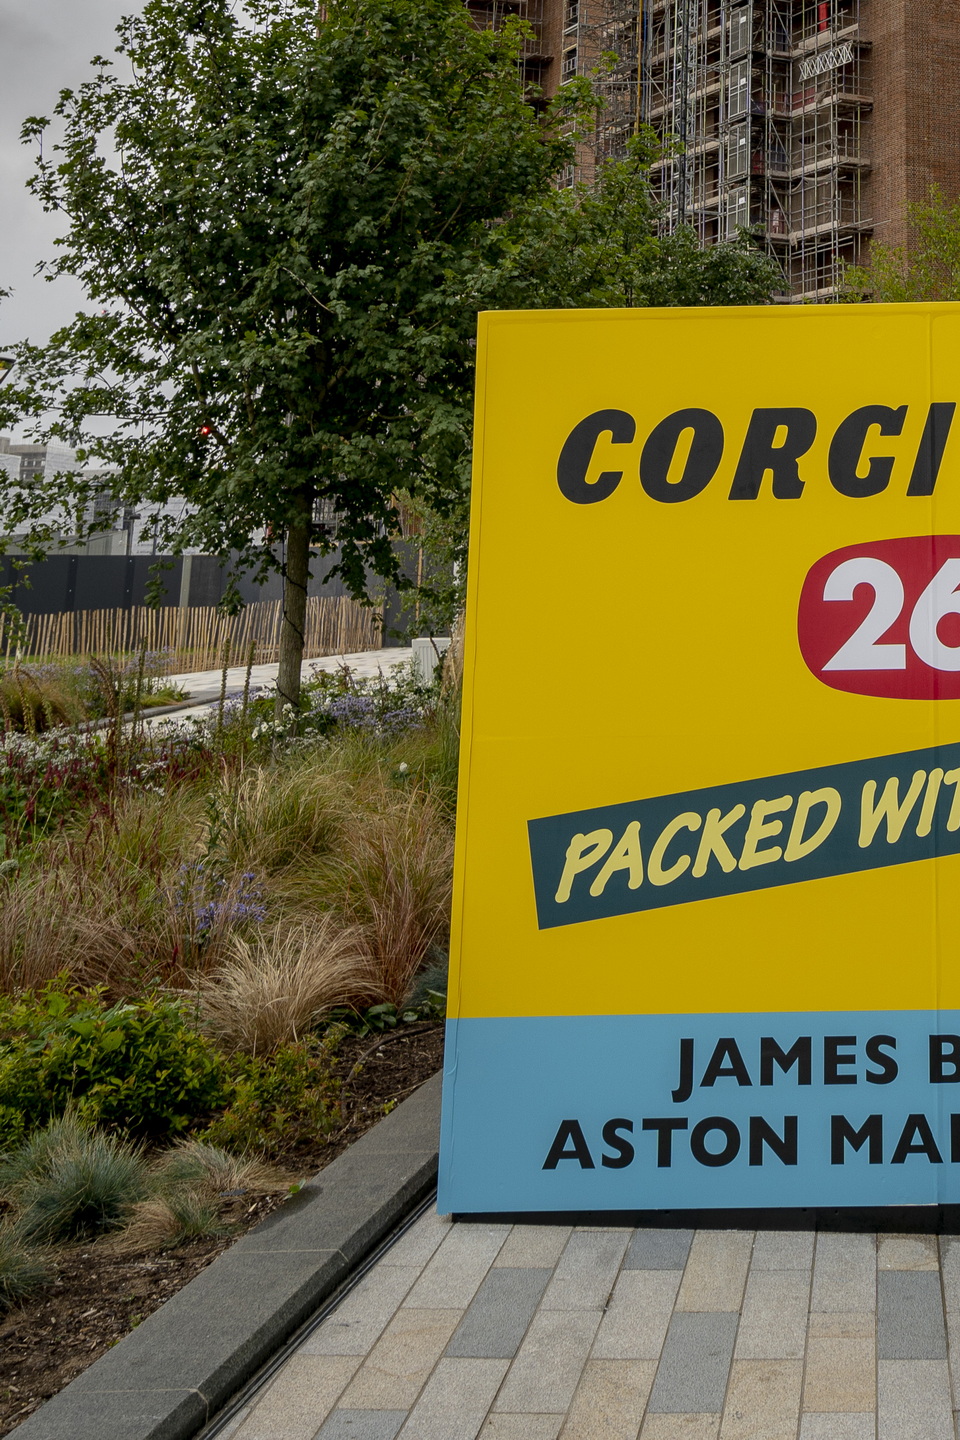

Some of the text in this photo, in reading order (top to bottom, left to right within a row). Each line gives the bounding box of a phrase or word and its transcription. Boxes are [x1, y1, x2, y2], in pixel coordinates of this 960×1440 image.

[556, 402, 957, 505] CORGI
[554, 786, 842, 904] PACKED
[671, 1034, 899, 1104] JAMES
[541, 1115, 798, 1171] ASTON
